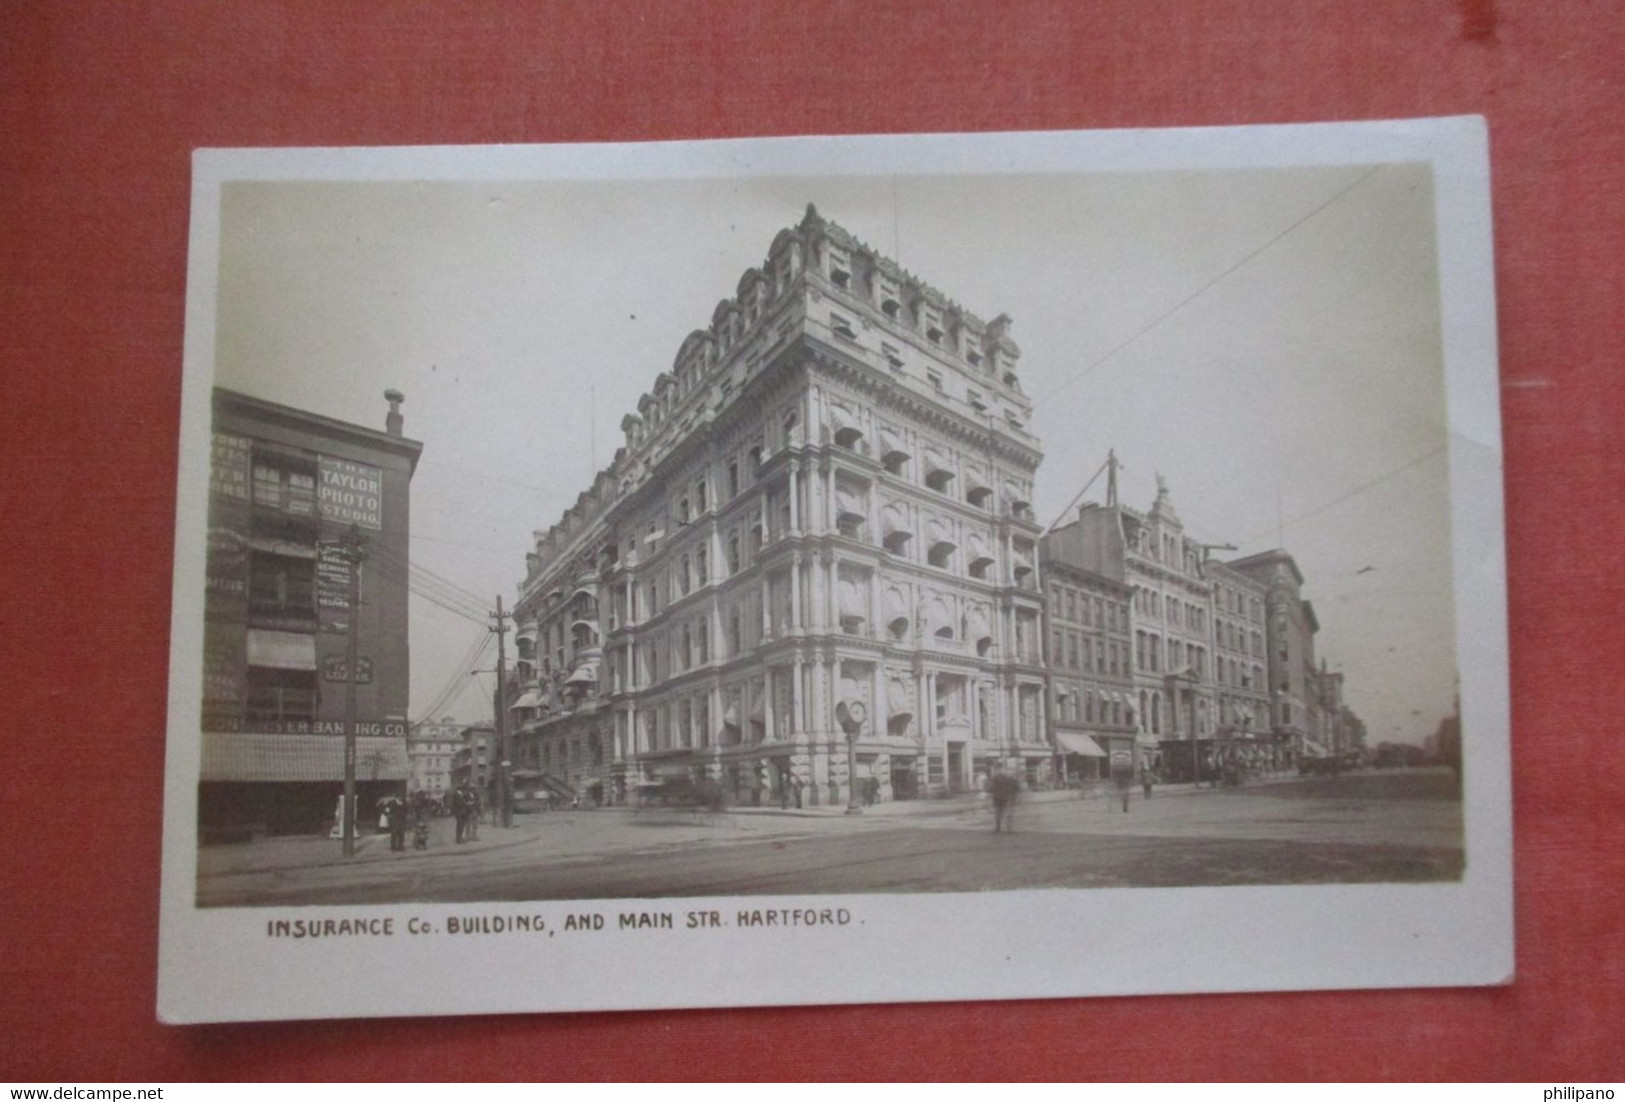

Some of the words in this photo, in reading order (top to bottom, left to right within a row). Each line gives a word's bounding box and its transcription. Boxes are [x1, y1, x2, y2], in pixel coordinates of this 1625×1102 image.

[321, 469, 378, 495] TAYLOR
[321, 487, 378, 511] PHOTO
[313, 721, 381, 735] BANING
[267, 917, 394, 938] INSURANCE
[407, 916, 440, 935] Co.
[446, 914, 555, 938] BUILDING,
[564, 914, 605, 931] AND
[618, 911, 673, 930] MAIN
